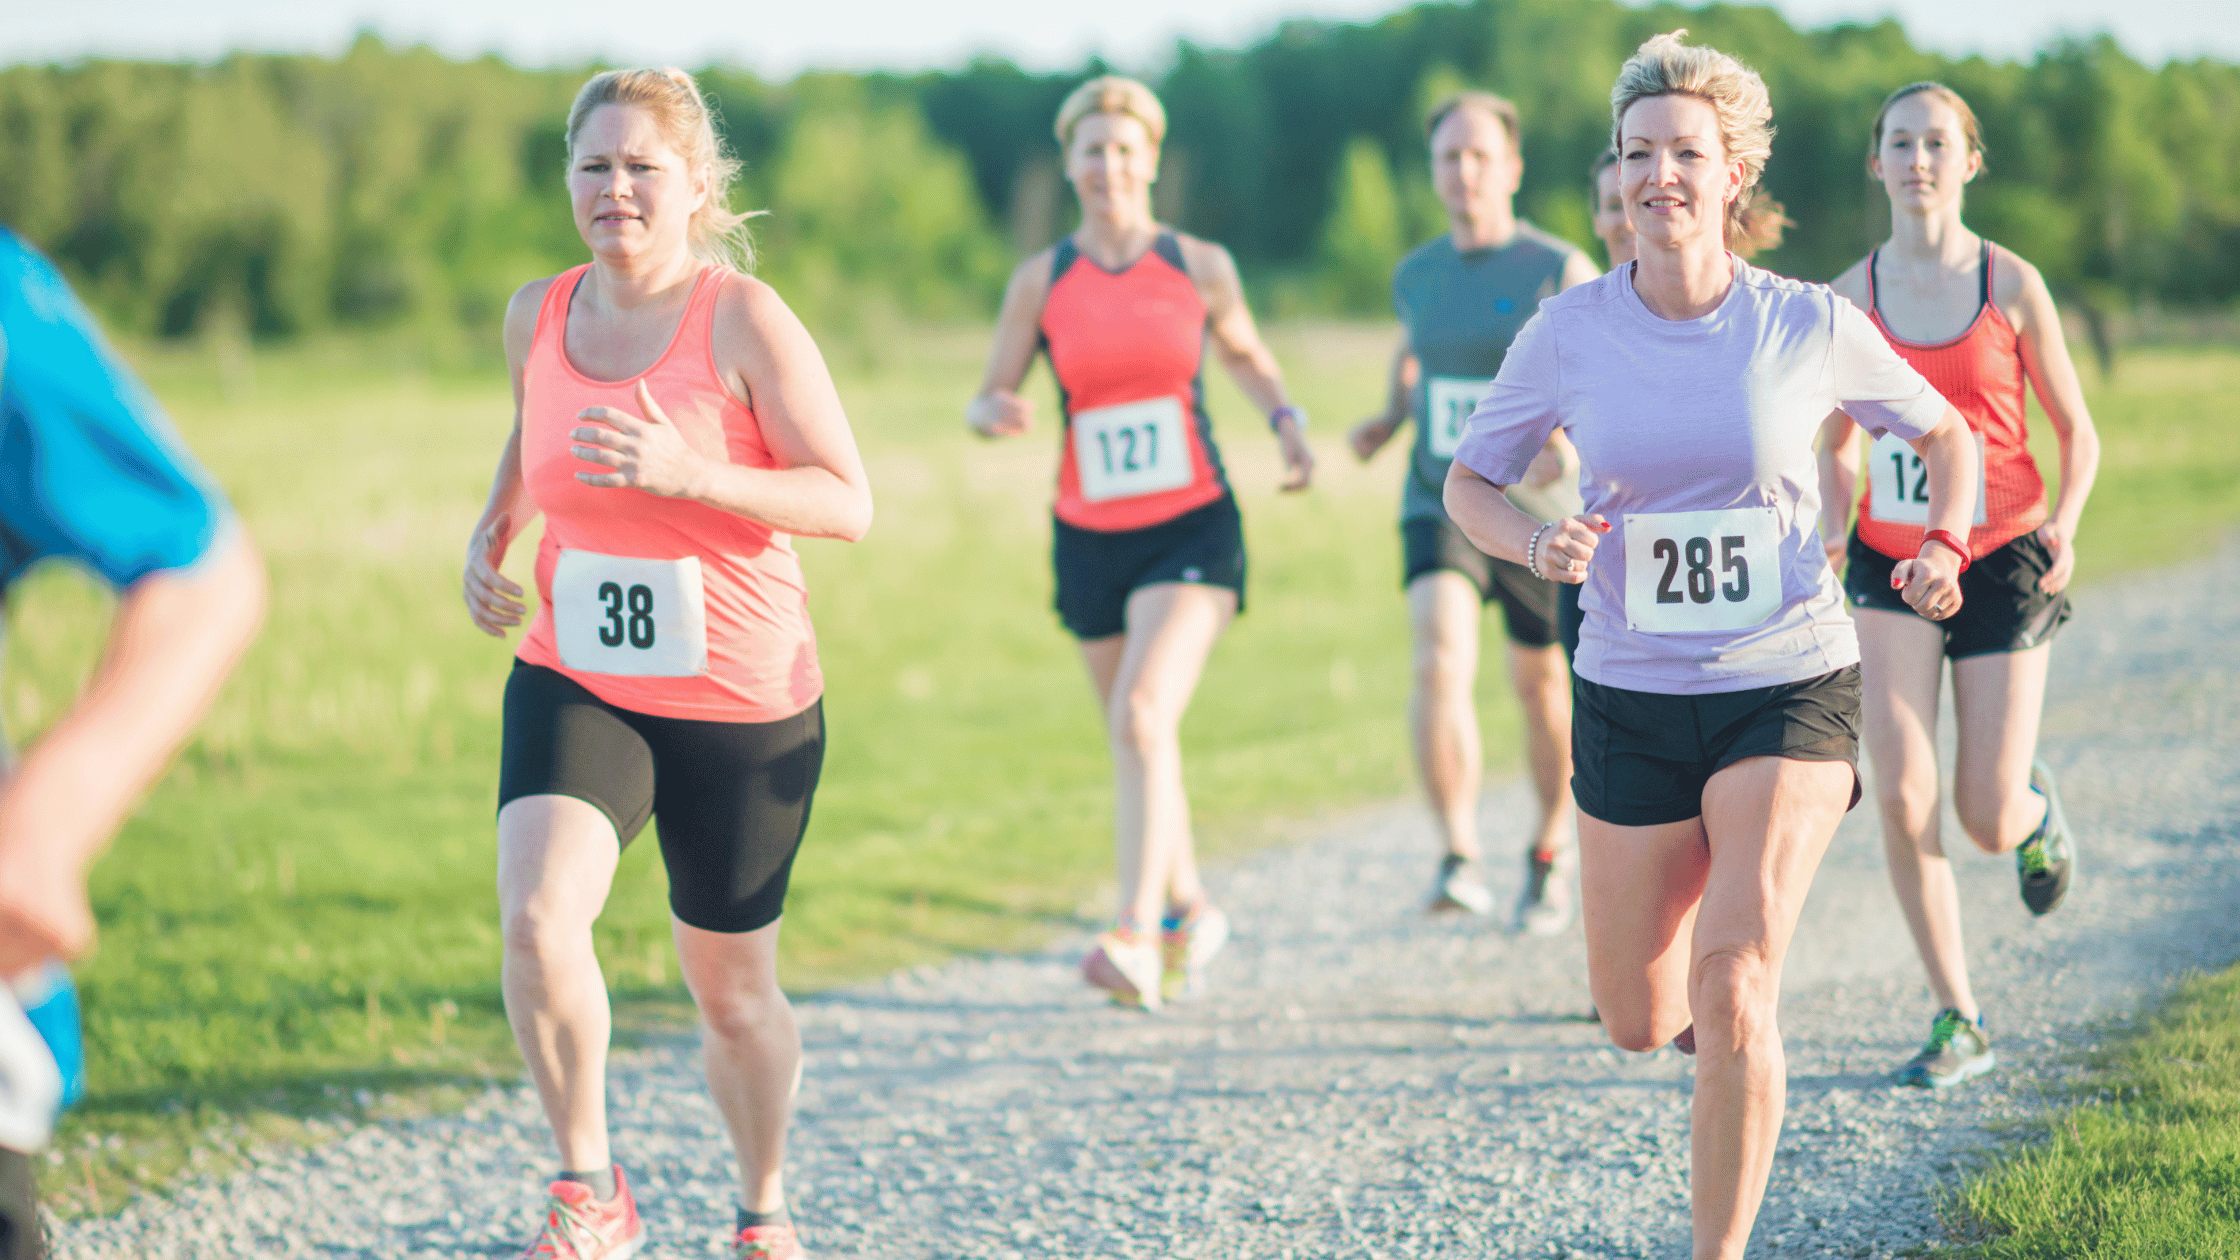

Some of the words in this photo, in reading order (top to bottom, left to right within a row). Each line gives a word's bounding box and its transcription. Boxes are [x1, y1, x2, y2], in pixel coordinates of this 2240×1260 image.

[1096, 422, 1158, 476] 127
[1890, 452, 1929, 503] 12
[1653, 535, 1750, 604] 285
[598, 581, 655, 650] 38
